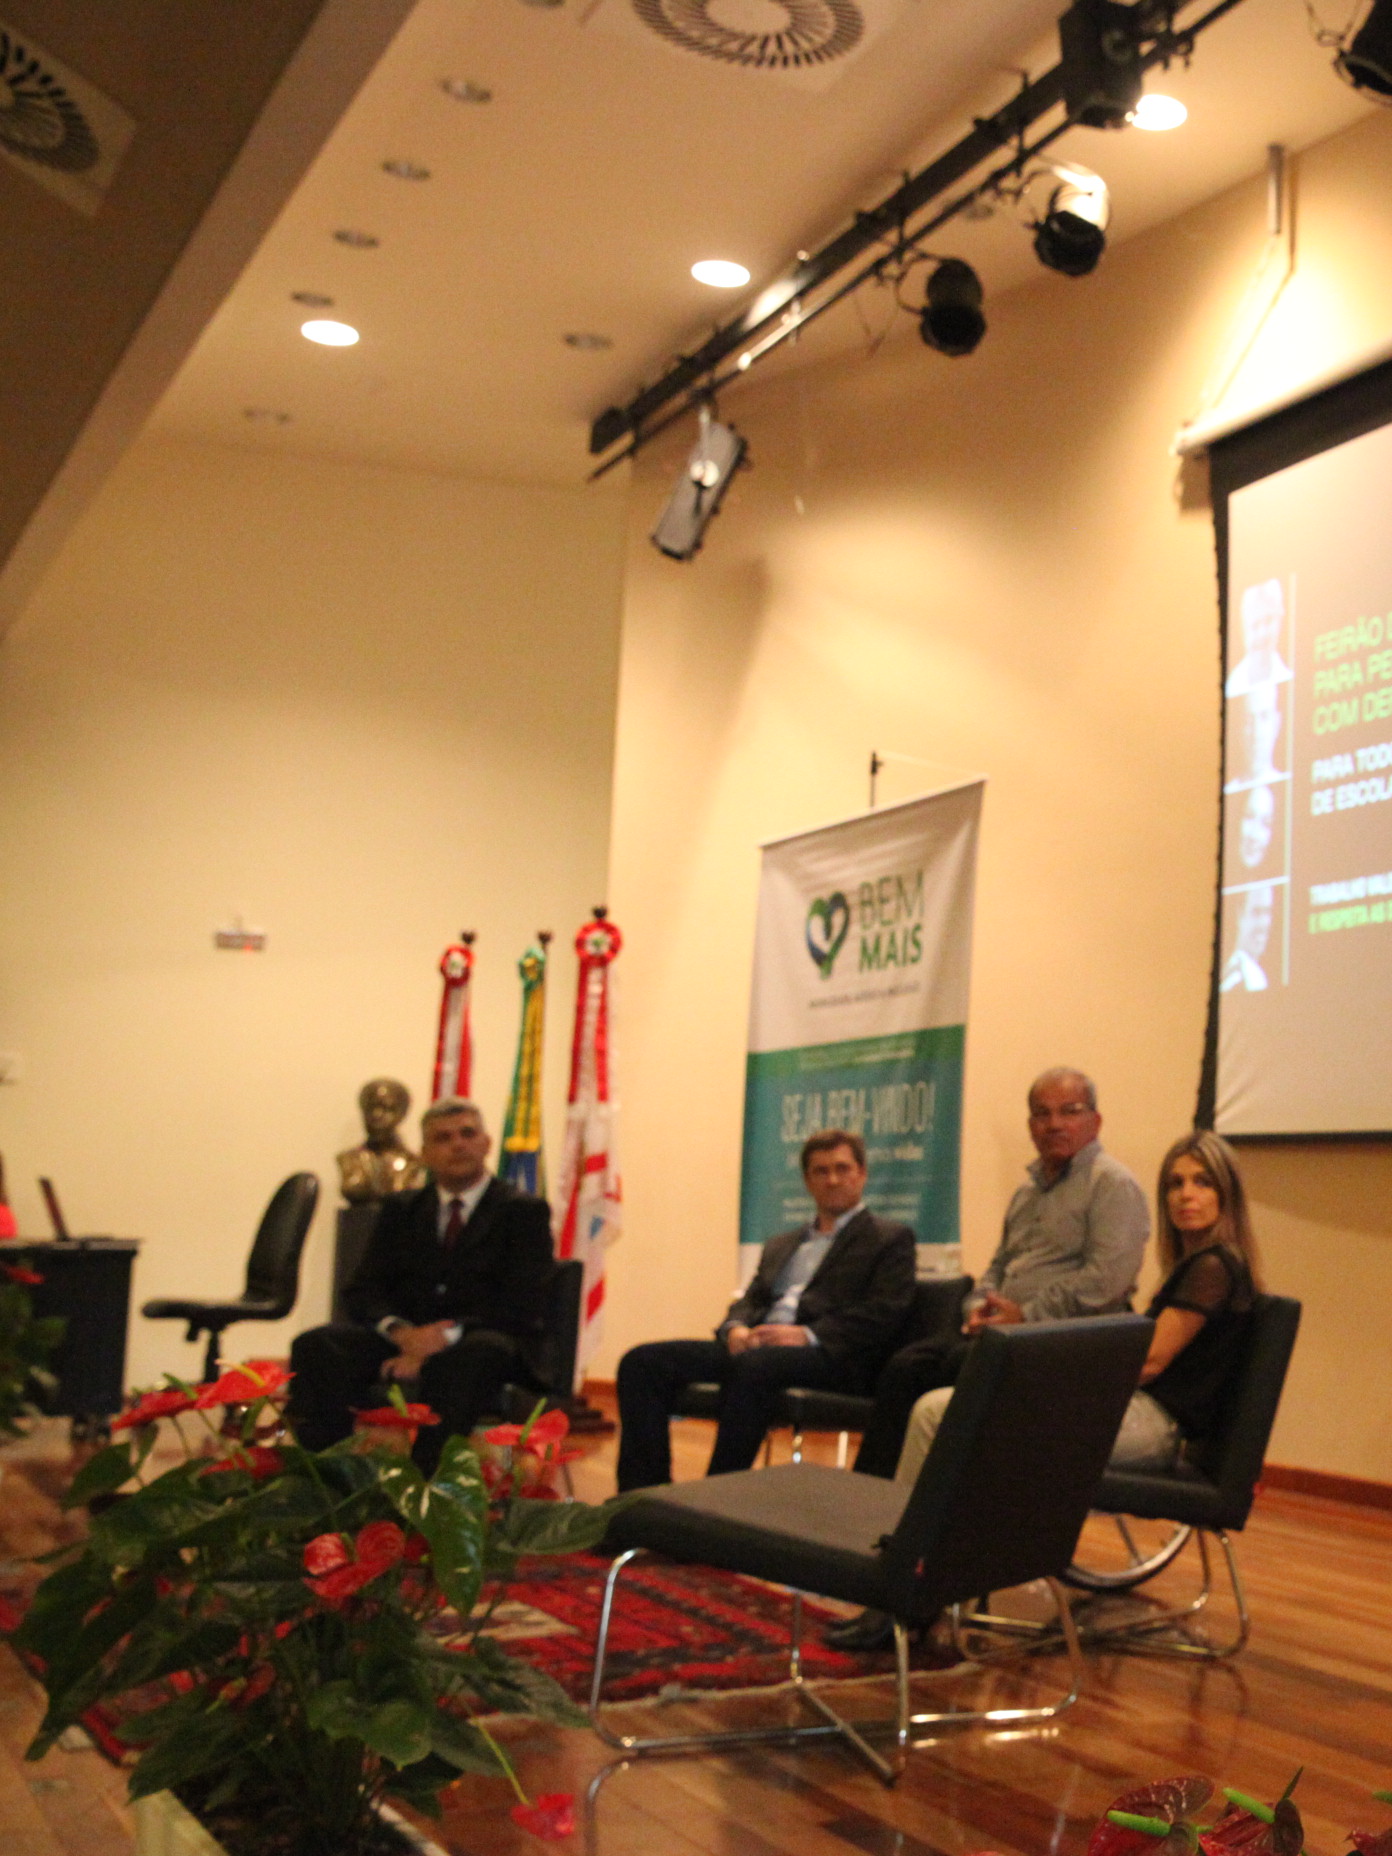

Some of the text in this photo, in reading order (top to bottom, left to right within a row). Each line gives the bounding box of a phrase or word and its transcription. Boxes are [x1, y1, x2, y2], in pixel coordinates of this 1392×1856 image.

[1314, 614, 1384, 663] FEIRÃO
[1314, 660, 1364, 698] PARA
[1313, 698, 1359, 735] COM
[1312, 753, 1354, 783] PARA
[1311, 788, 1334, 816] DE
[858, 868, 924, 931] BEM
[858, 923, 922, 974] MAIS
